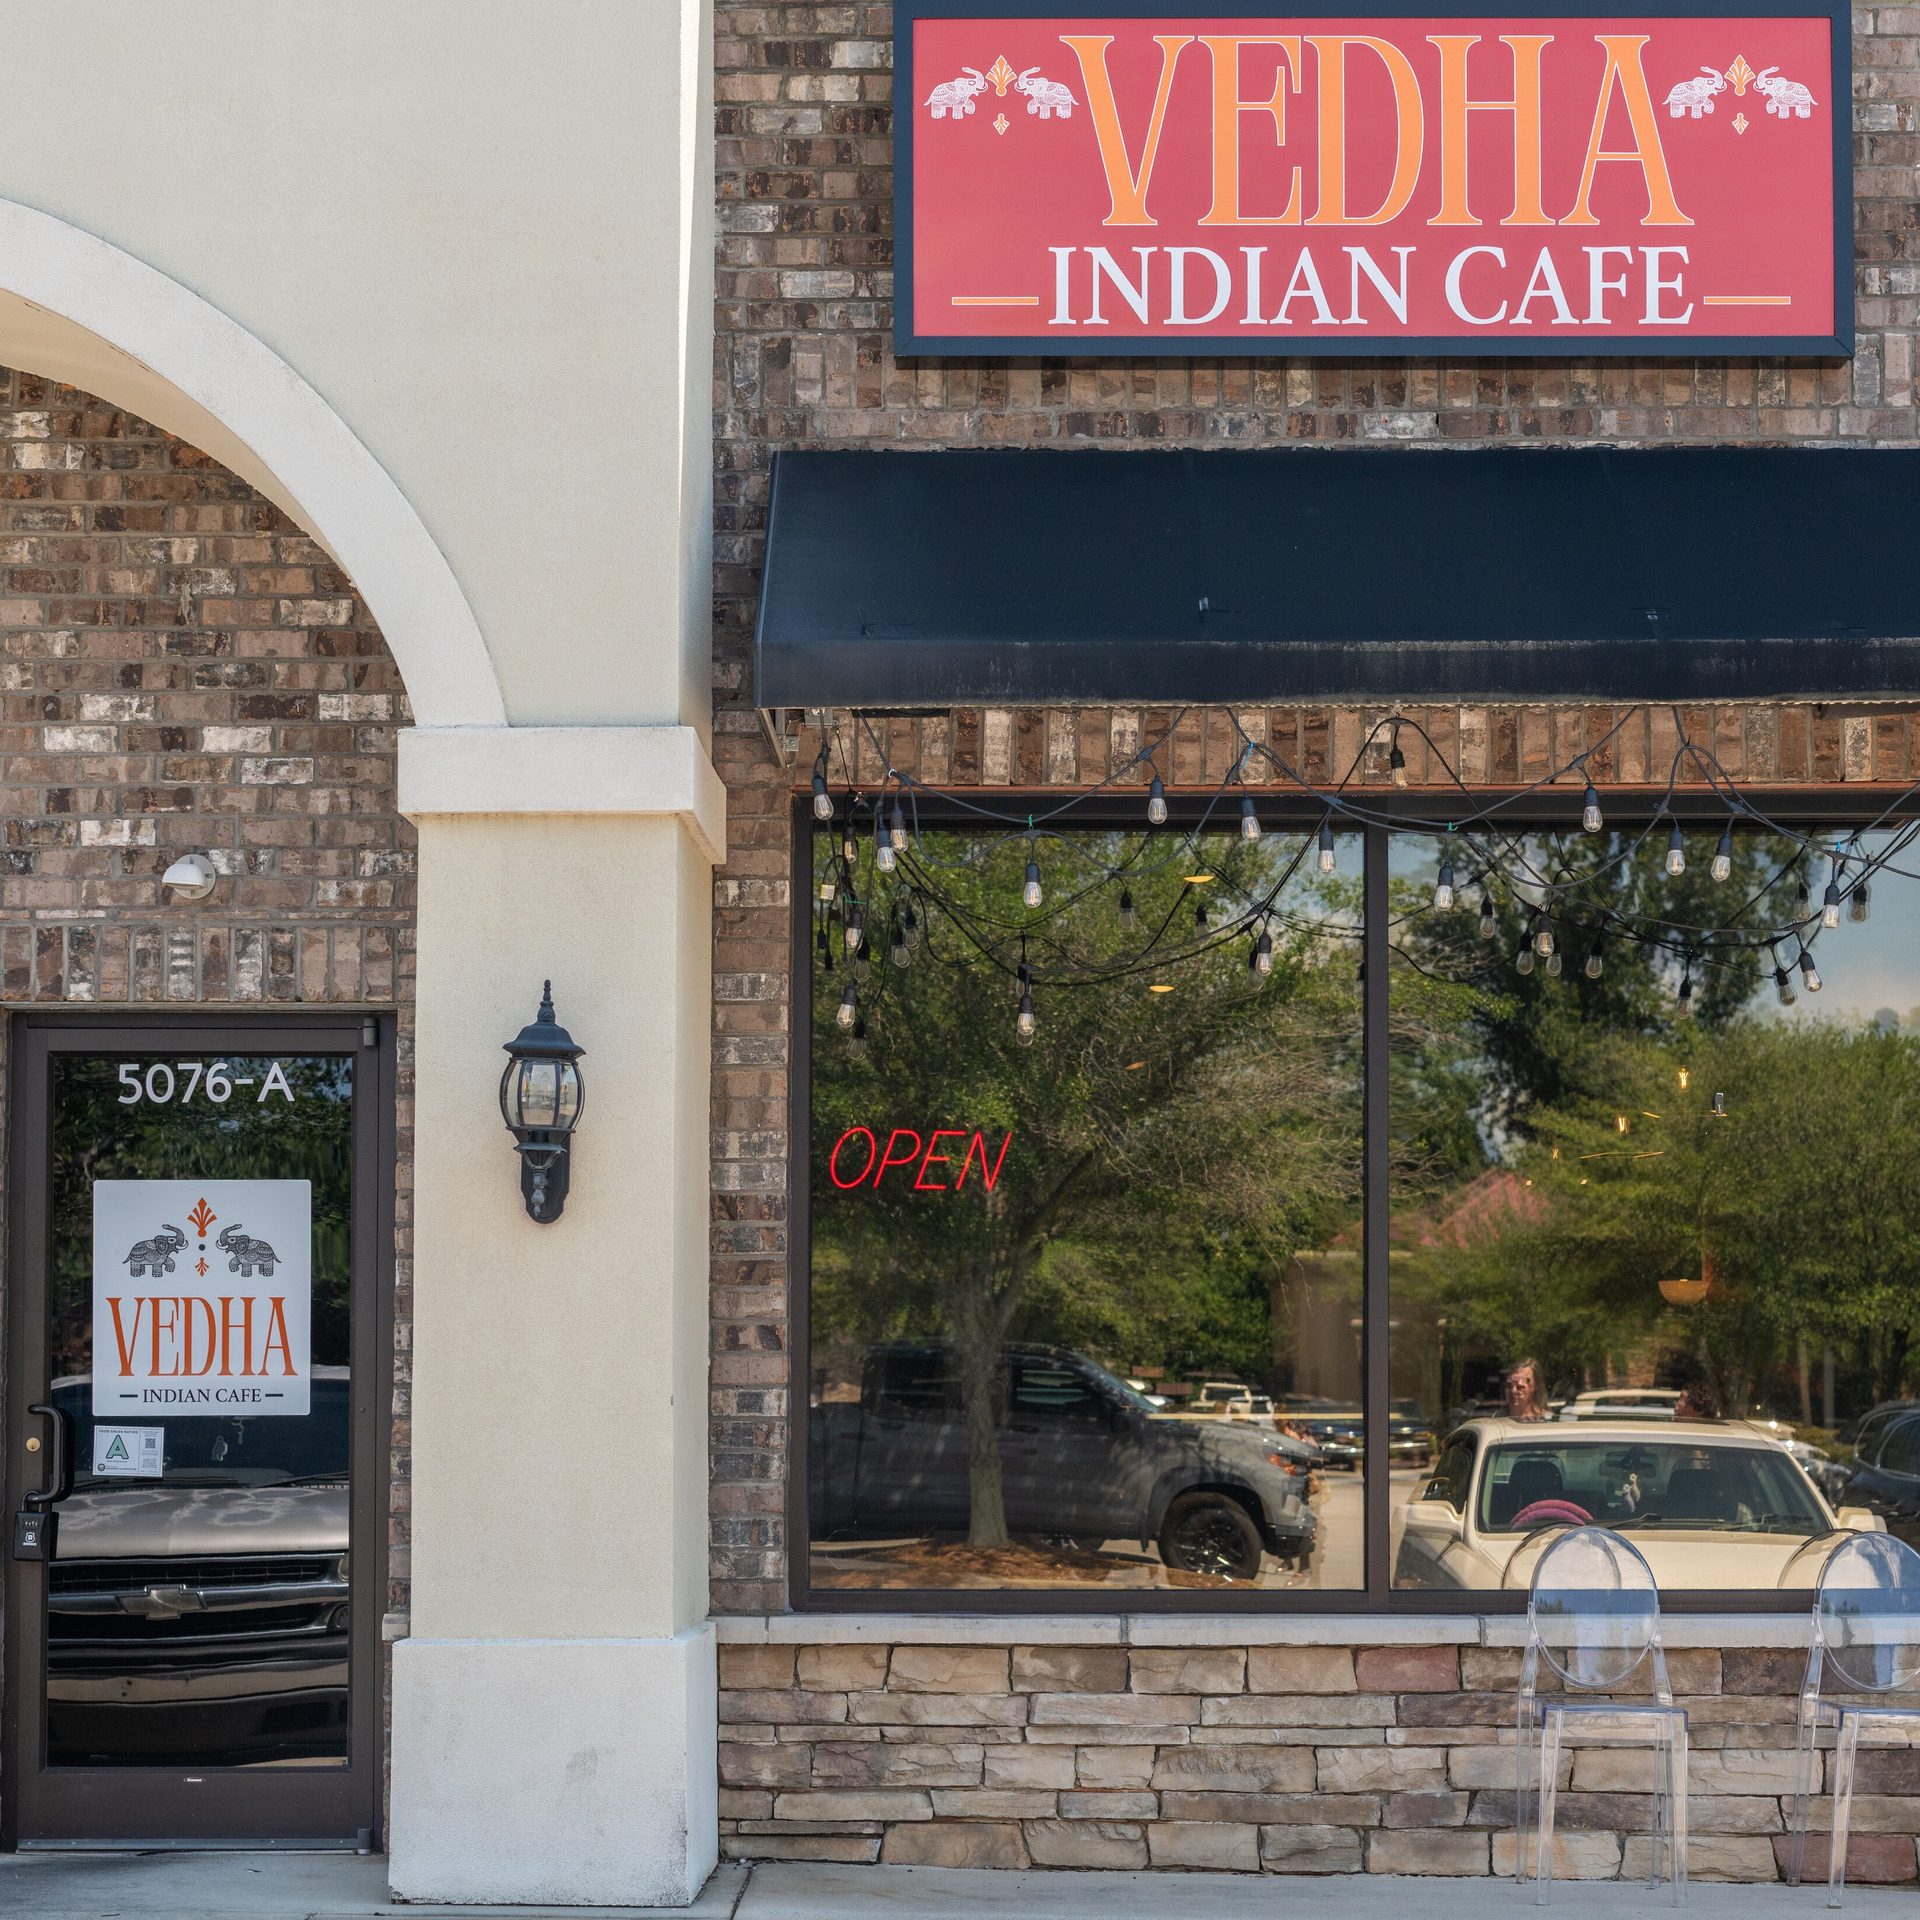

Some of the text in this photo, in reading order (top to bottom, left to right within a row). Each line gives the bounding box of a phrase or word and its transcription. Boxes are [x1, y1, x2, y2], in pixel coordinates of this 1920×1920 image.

[1059, 35, 1695, 227] VEDHA
[1048, 245, 1694, 325] INDIAN CAFE
[117, 1061, 295, 1104] 5076-A
[829, 1126, 1012, 1192] OPEN
[105, 1296, 298, 1377] VEDHA
[142, 1388, 262, 1403] INDIAN CAFE
[106, 1434, 130, 1460] A
